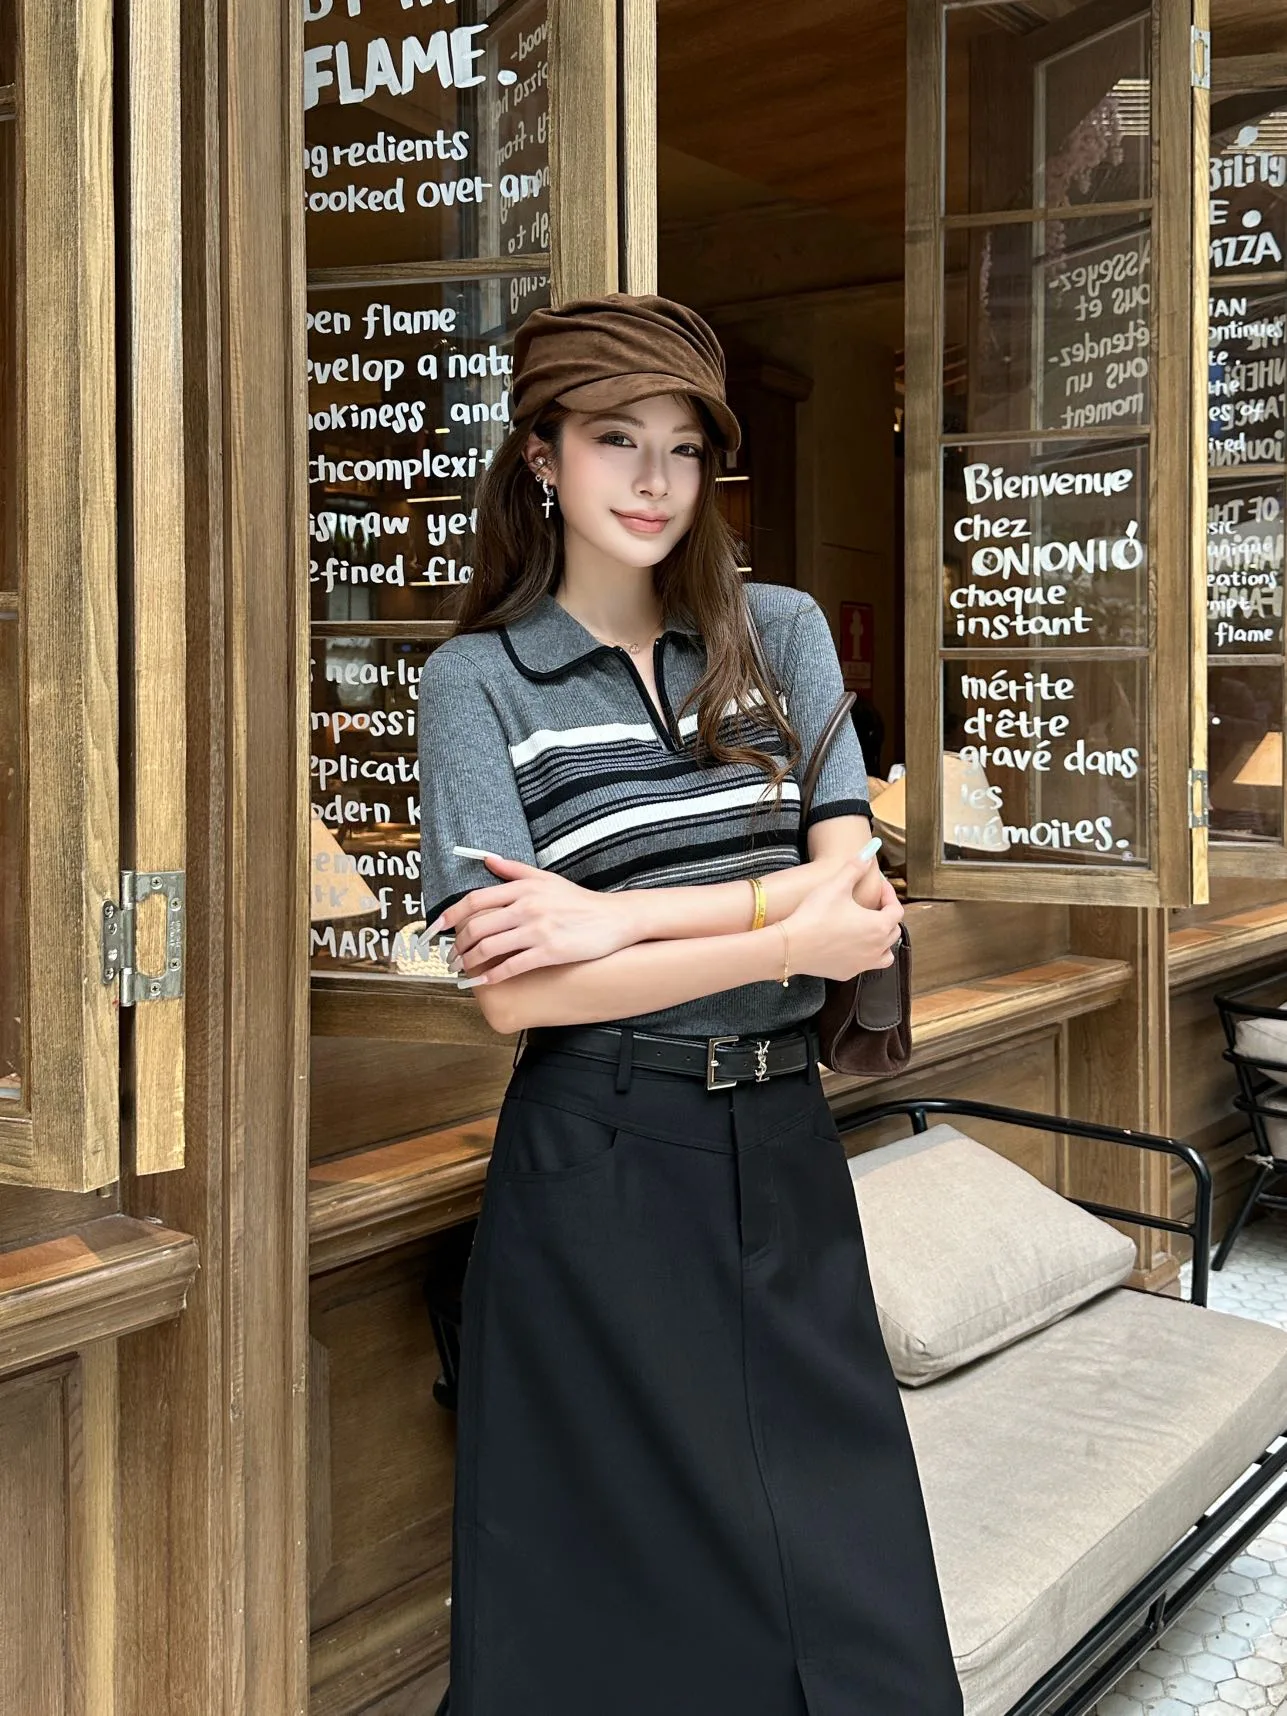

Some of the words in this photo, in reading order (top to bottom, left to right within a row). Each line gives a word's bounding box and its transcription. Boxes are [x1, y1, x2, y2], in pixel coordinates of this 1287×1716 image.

[304, 177, 405, 213] ooked
[416, 176, 492, 208] over
[362, 304, 457, 340] flame
[417, 353, 438, 380] a
[450, 391, 510, 425] and
[1240, 402, 1264, 423] of
[963, 462, 1133, 504] Bienvenue
[954, 513, 1032, 542] chez
[971, 520, 1143, 580] ONIONIÓ
[949, 583, 1068, 614] chaque
[956, 607, 1093, 640] instant
[1214, 622, 1274, 647] flame
[961, 669, 1074, 702] mérite
[963, 708, 1071, 740] d'être
[958, 740, 1053, 777] gravé
[1063, 738, 1139, 779] dans
[960, 783, 1004, 811] les
[953, 815, 1130, 851] mémoires.
